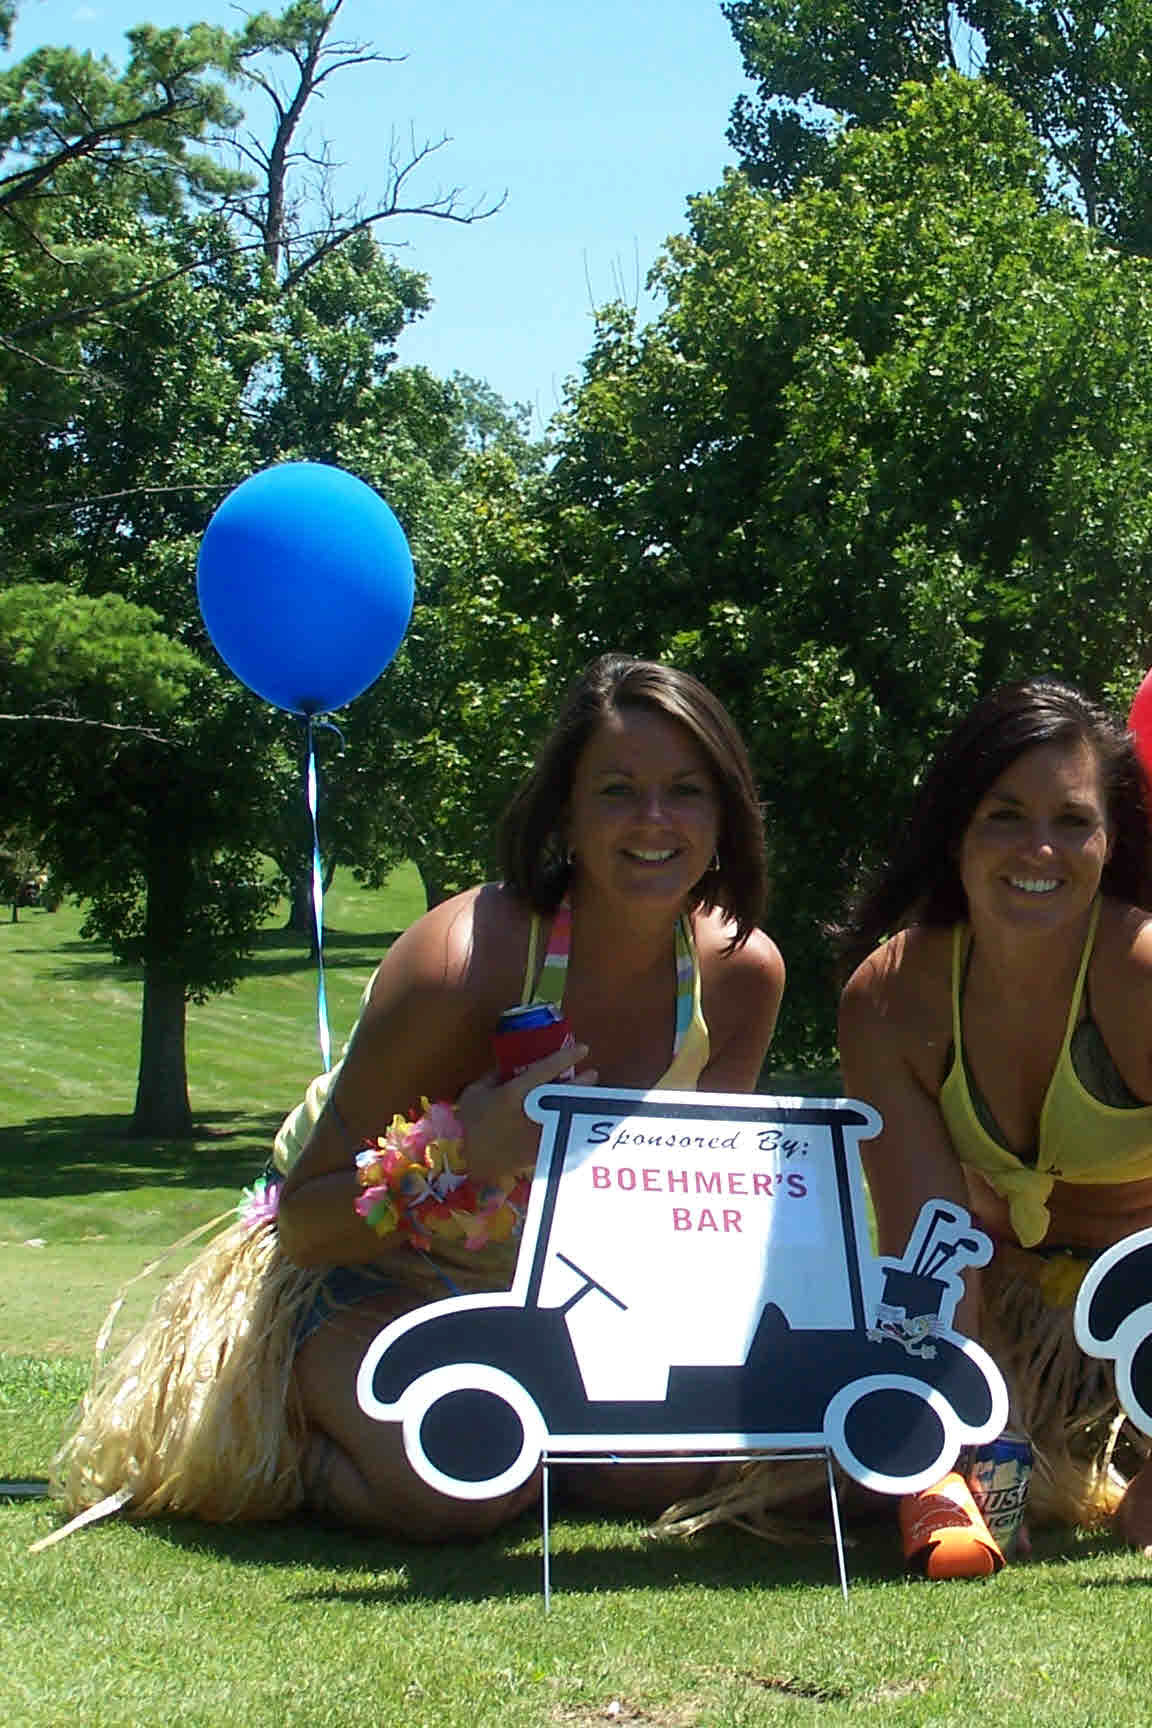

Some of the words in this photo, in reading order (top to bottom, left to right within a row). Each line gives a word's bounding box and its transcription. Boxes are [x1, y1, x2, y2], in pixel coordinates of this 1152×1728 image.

[586, 1121, 742, 1150] Sponsored
[757, 1129, 810, 1159] By:
[591, 1165, 808, 1198] BOEHMER'S
[672, 1207, 743, 1233] BAR
